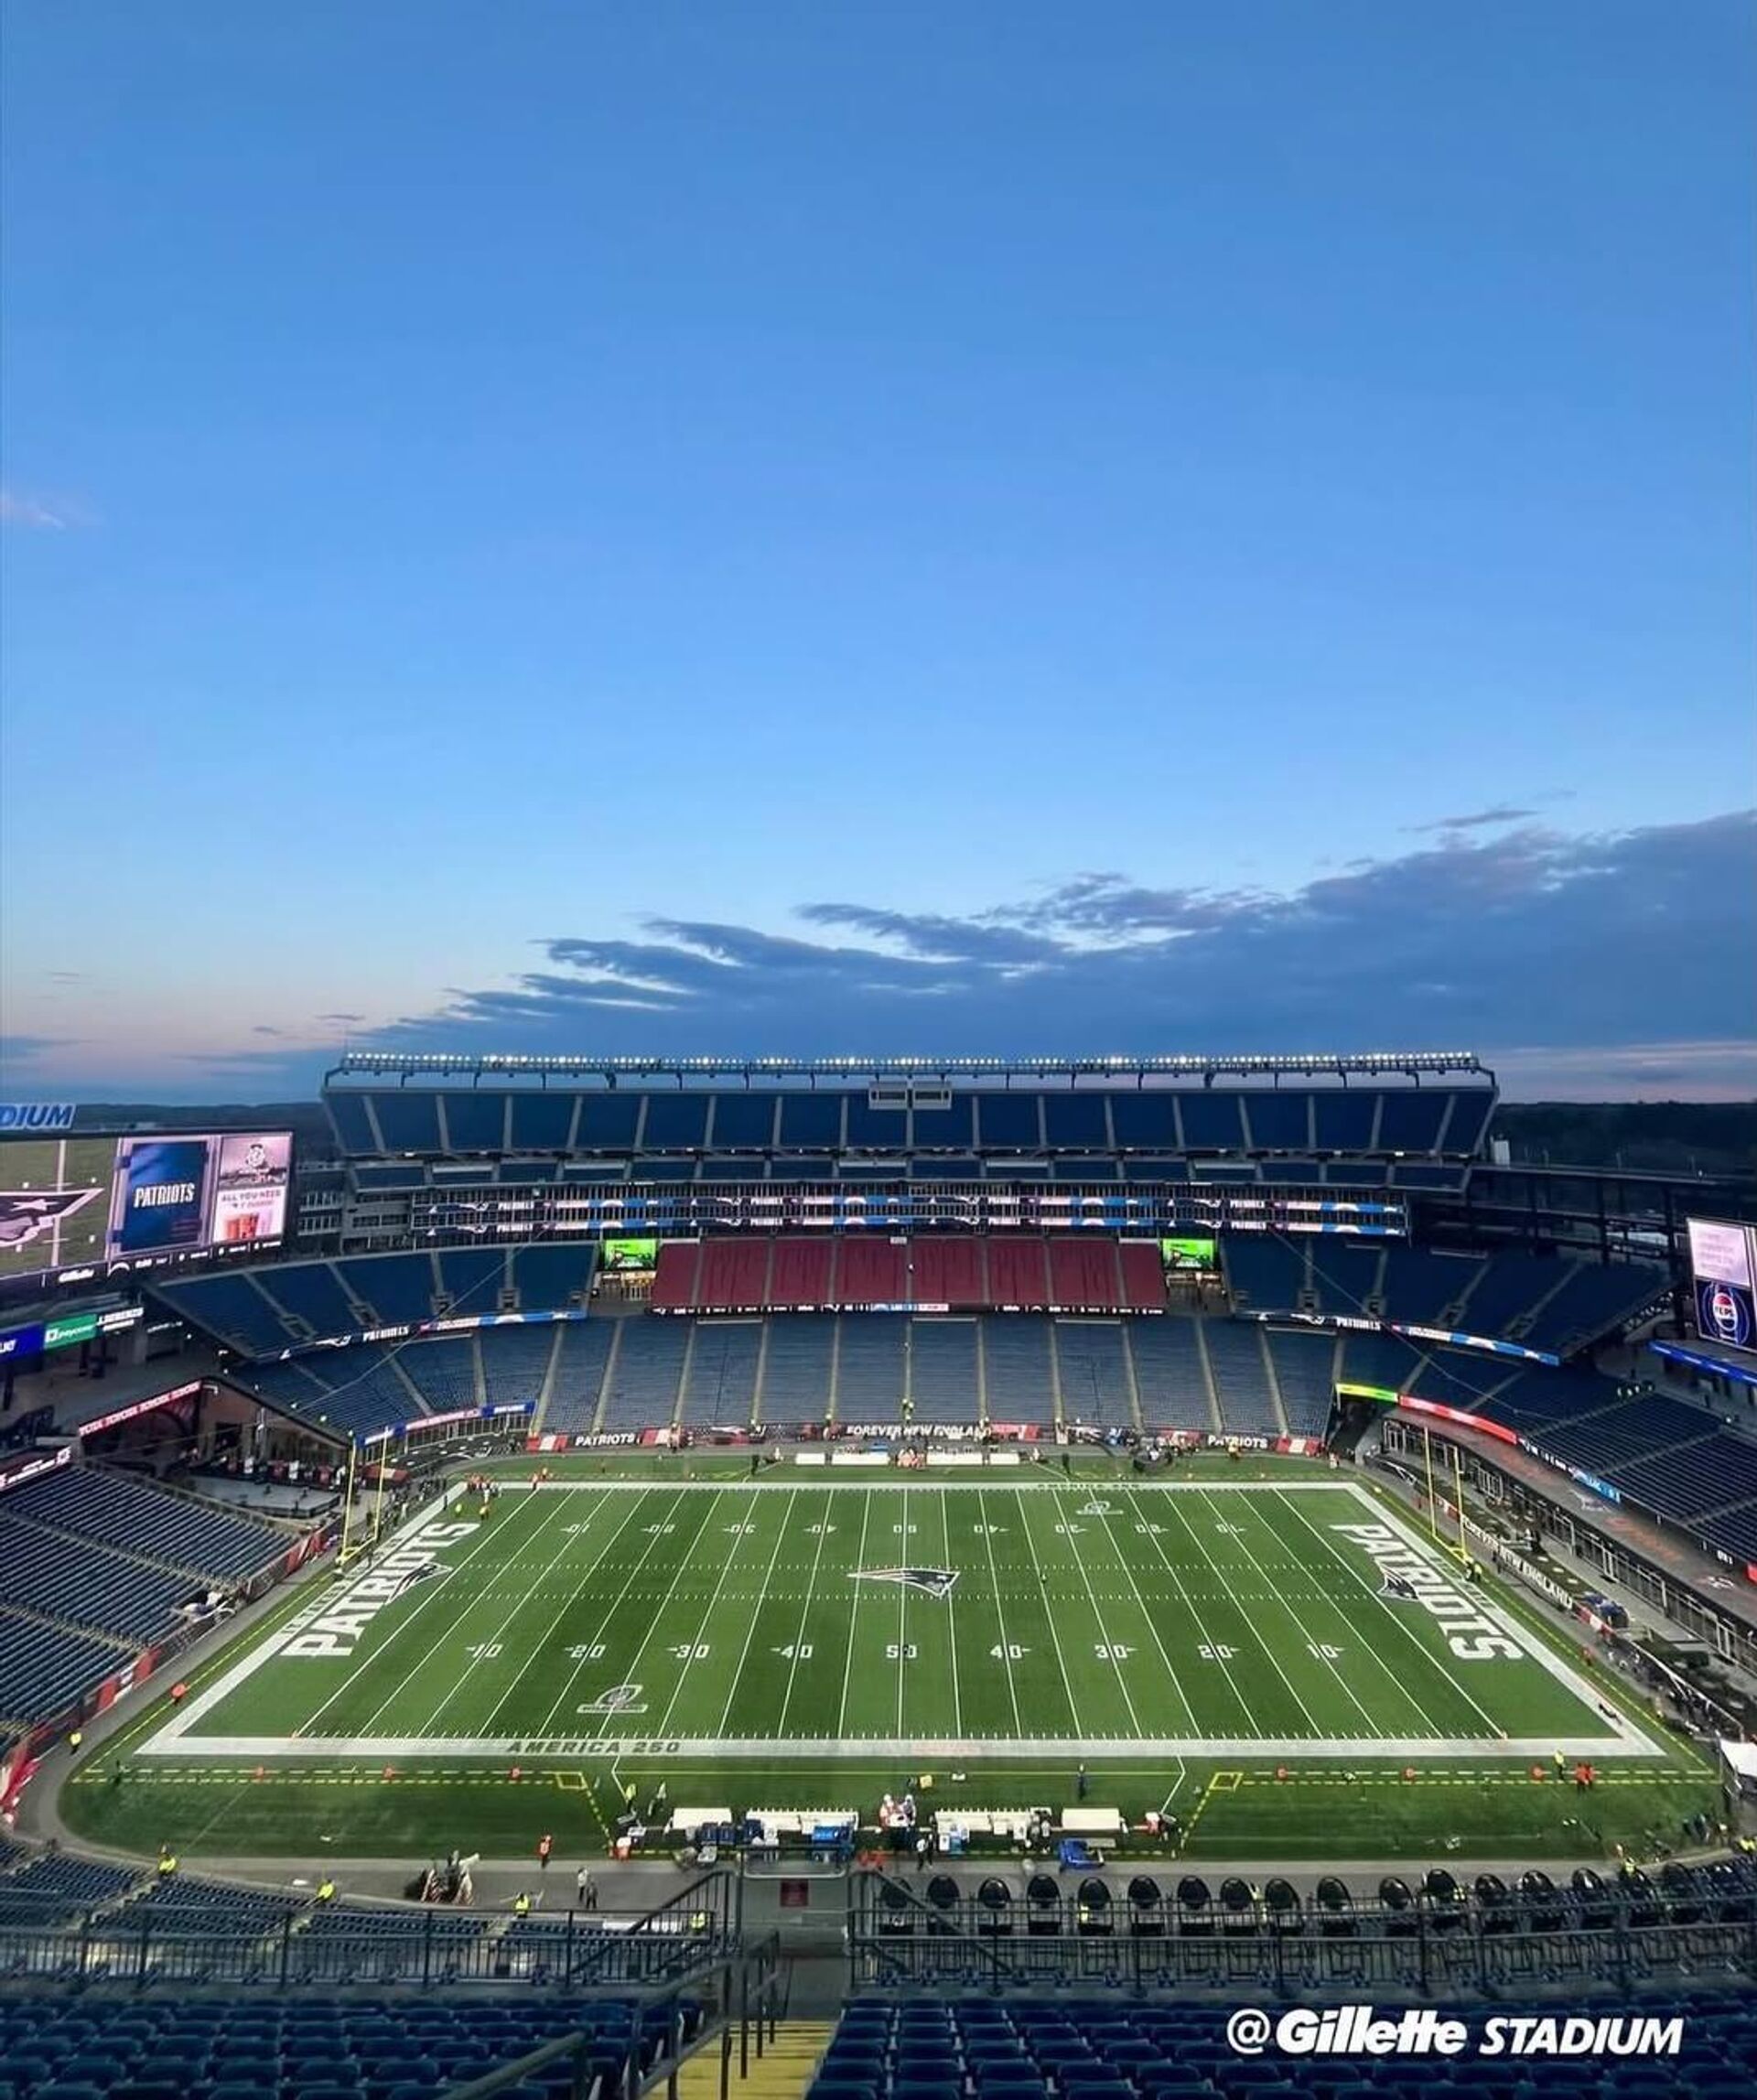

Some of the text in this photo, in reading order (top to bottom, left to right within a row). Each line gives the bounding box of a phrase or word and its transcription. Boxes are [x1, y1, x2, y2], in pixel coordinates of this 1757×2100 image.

[134, 1182, 195, 1208] PATRIOTS
[846, 1425, 901, 1437] FOREVER
[903, 1425, 932, 1437] NEW
[575, 1432, 633, 1447] PATRIOTS
[1208, 1435, 1267, 1449] PATRIOTS
[279, 1523, 480, 1656] PATRIOTS
[1329, 1524, 1524, 1659] PATRIOTS
[471, 1644, 503, 1658] 10
[570, 1644, 607, 1658] 20
[676, 1644, 709, 1658] 30
[781, 1644, 814, 1658] 40
[887, 1644, 918, 1658] 50
[990, 1644, 1023, 1658] 40
[1094, 1644, 1127, 1658] 30
[1198, 1644, 1234, 1658] 20
[1306, 1644, 1339, 1658] 10
[505, 1740, 681, 1754] AMERICA 250
